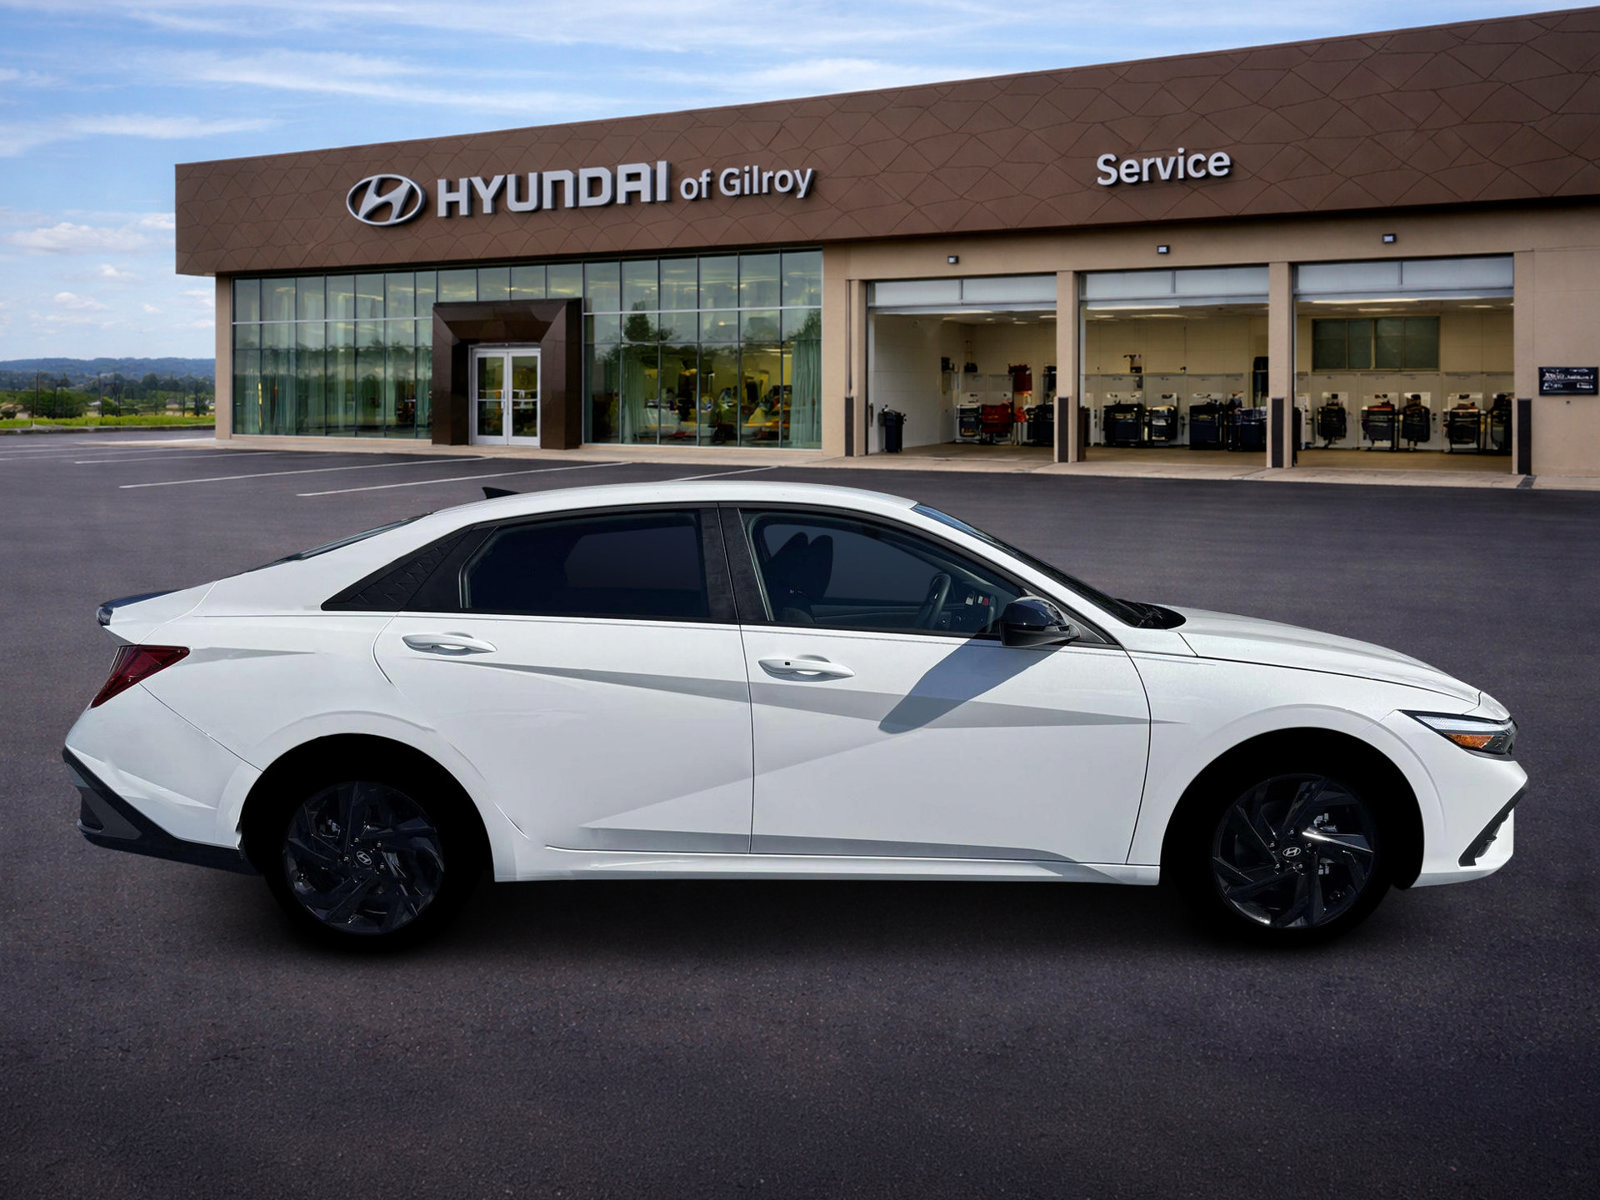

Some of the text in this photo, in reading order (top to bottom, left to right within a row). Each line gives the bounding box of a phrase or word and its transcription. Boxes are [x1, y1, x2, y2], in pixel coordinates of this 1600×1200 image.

[436, 160, 669, 218] HYUNDAI
[680, 168, 711, 200] of
[719, 165, 813, 199] Gilroy
[1096, 147, 1232, 186] Service
